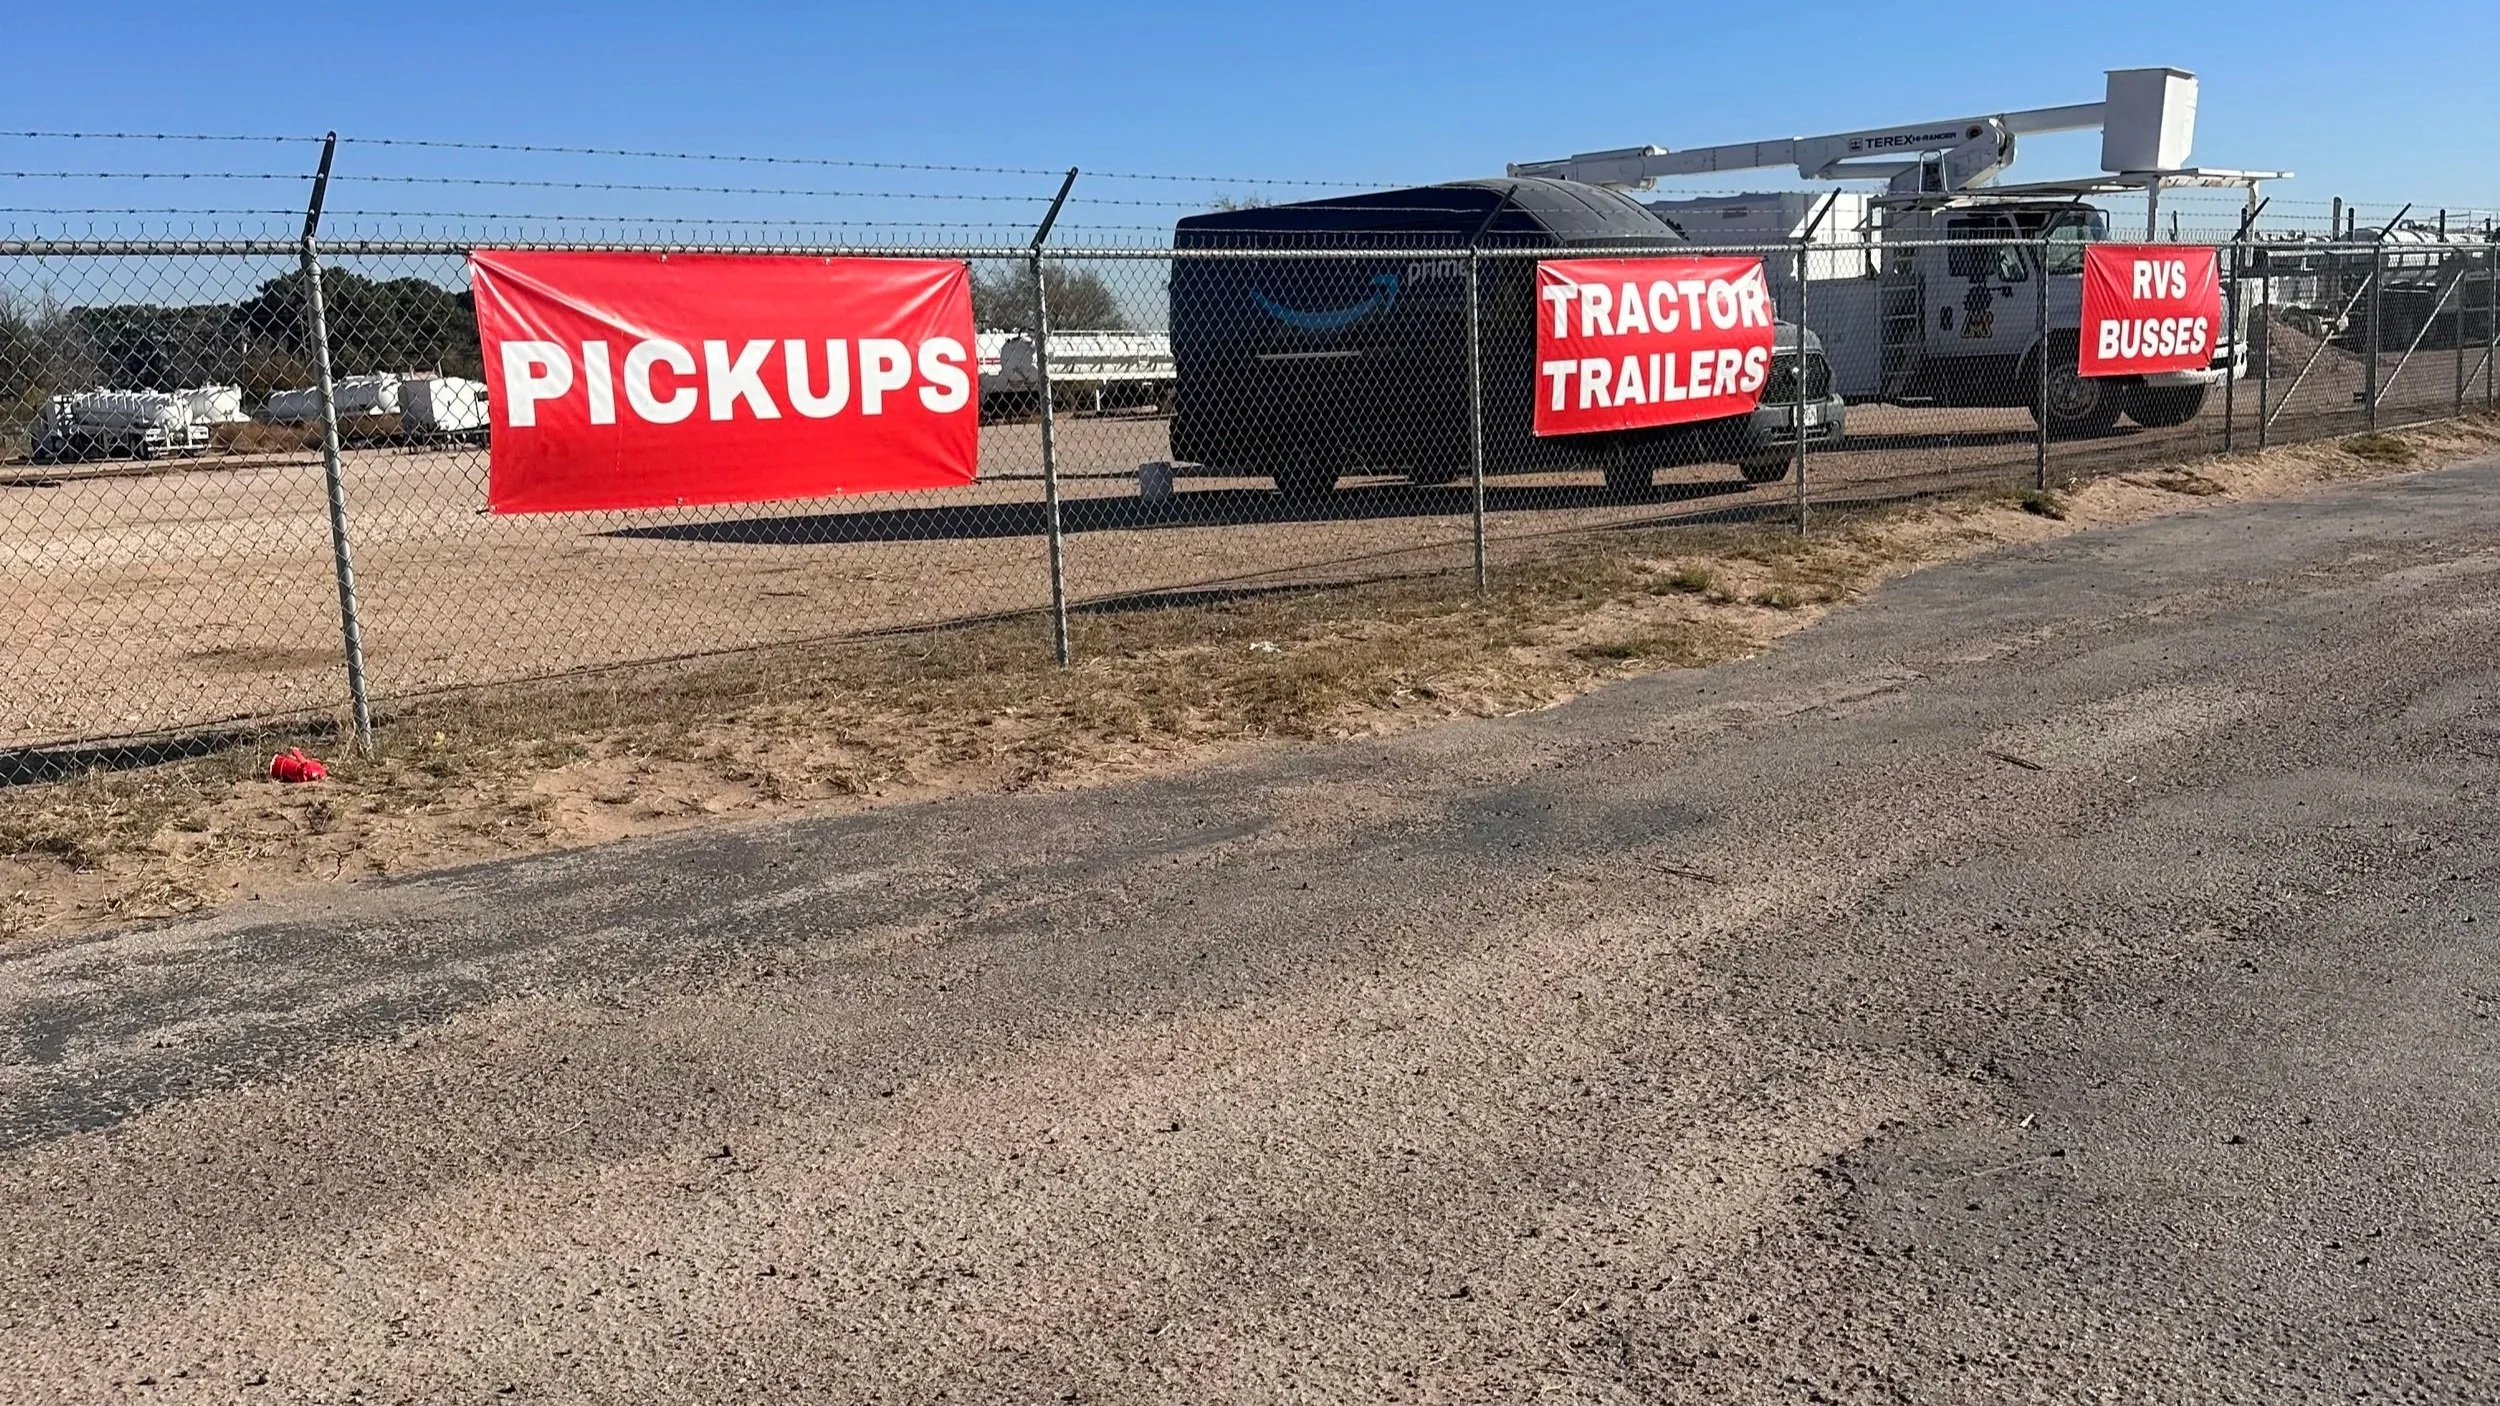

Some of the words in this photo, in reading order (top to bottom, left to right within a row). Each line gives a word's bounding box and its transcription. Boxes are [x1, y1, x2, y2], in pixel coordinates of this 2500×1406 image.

[1865, 134, 1913, 148] TEREX
[2132, 259, 2188, 300] RVS
[1541, 279, 1771, 338] TRACTOR
[2097, 316, 2208, 359] BUSSES
[499, 337, 970, 427] PICKUPS
[1542, 346, 1768, 411] TRAILERS
